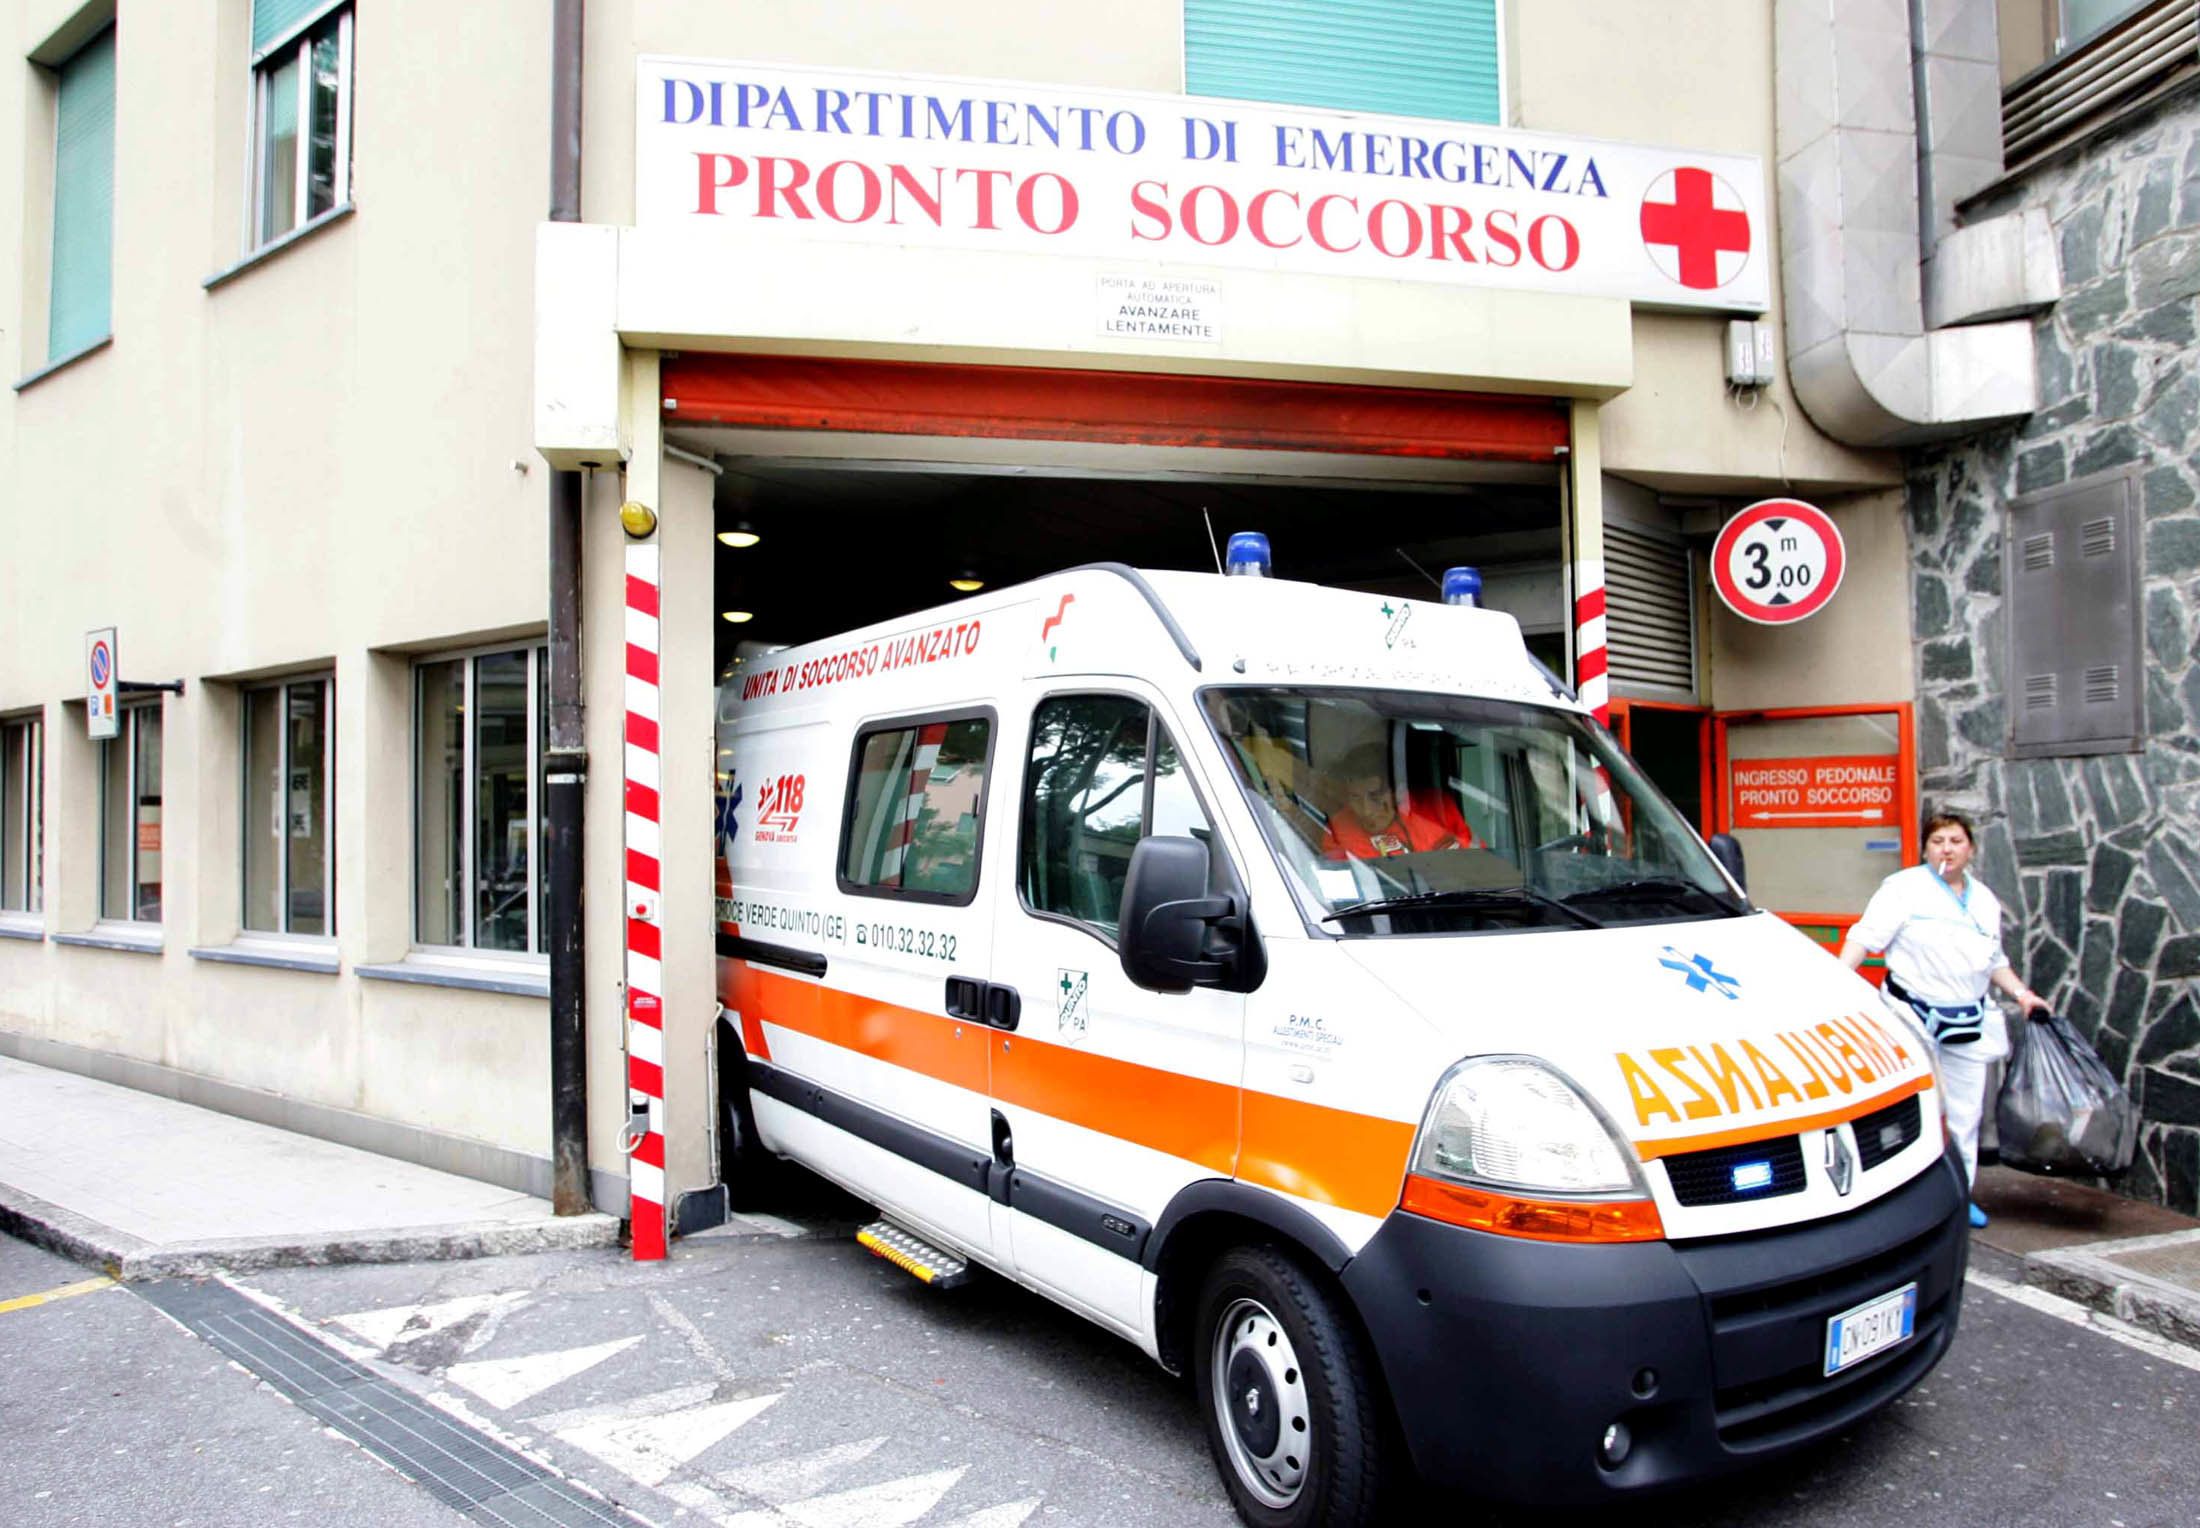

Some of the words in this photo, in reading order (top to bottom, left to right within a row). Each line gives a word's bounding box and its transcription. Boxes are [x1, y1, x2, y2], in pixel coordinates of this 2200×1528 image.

[660, 77, 1146, 155] DIPARTIMENTO
[1180, 116, 1239, 163] DI
[1271, 124, 1610, 198] EMERGENZA
[691, 151, 1080, 235] PRONTO
[1130, 180, 1581, 272] SOCCORSO
[1101, 276, 1135, 288] PORTA
[1119, 305, 1200, 321] AVANZARE
[1106, 319, 1213, 337] LENTAMENTE
[1780, 537, 1797, 552] m
[782, 664, 799, 692] DI
[798, 645, 879, 690] SOCCORSO
[881, 619, 981, 672] AVANZATO
[1734, 768, 1808, 786] INGRESSO
[1816, 766, 1896, 784] PEDONALE
[776, 774, 805, 813] 118
[1740, 789, 1799, 806] PRONTO
[1807, 787, 1892, 804] SOCCORSO
[746, 902, 777, 927] VERDE
[779, 908, 820, 935] QUINTO
[822, 913, 848, 945] (GE)
[872, 922, 957, 962] 010.32.32.32
